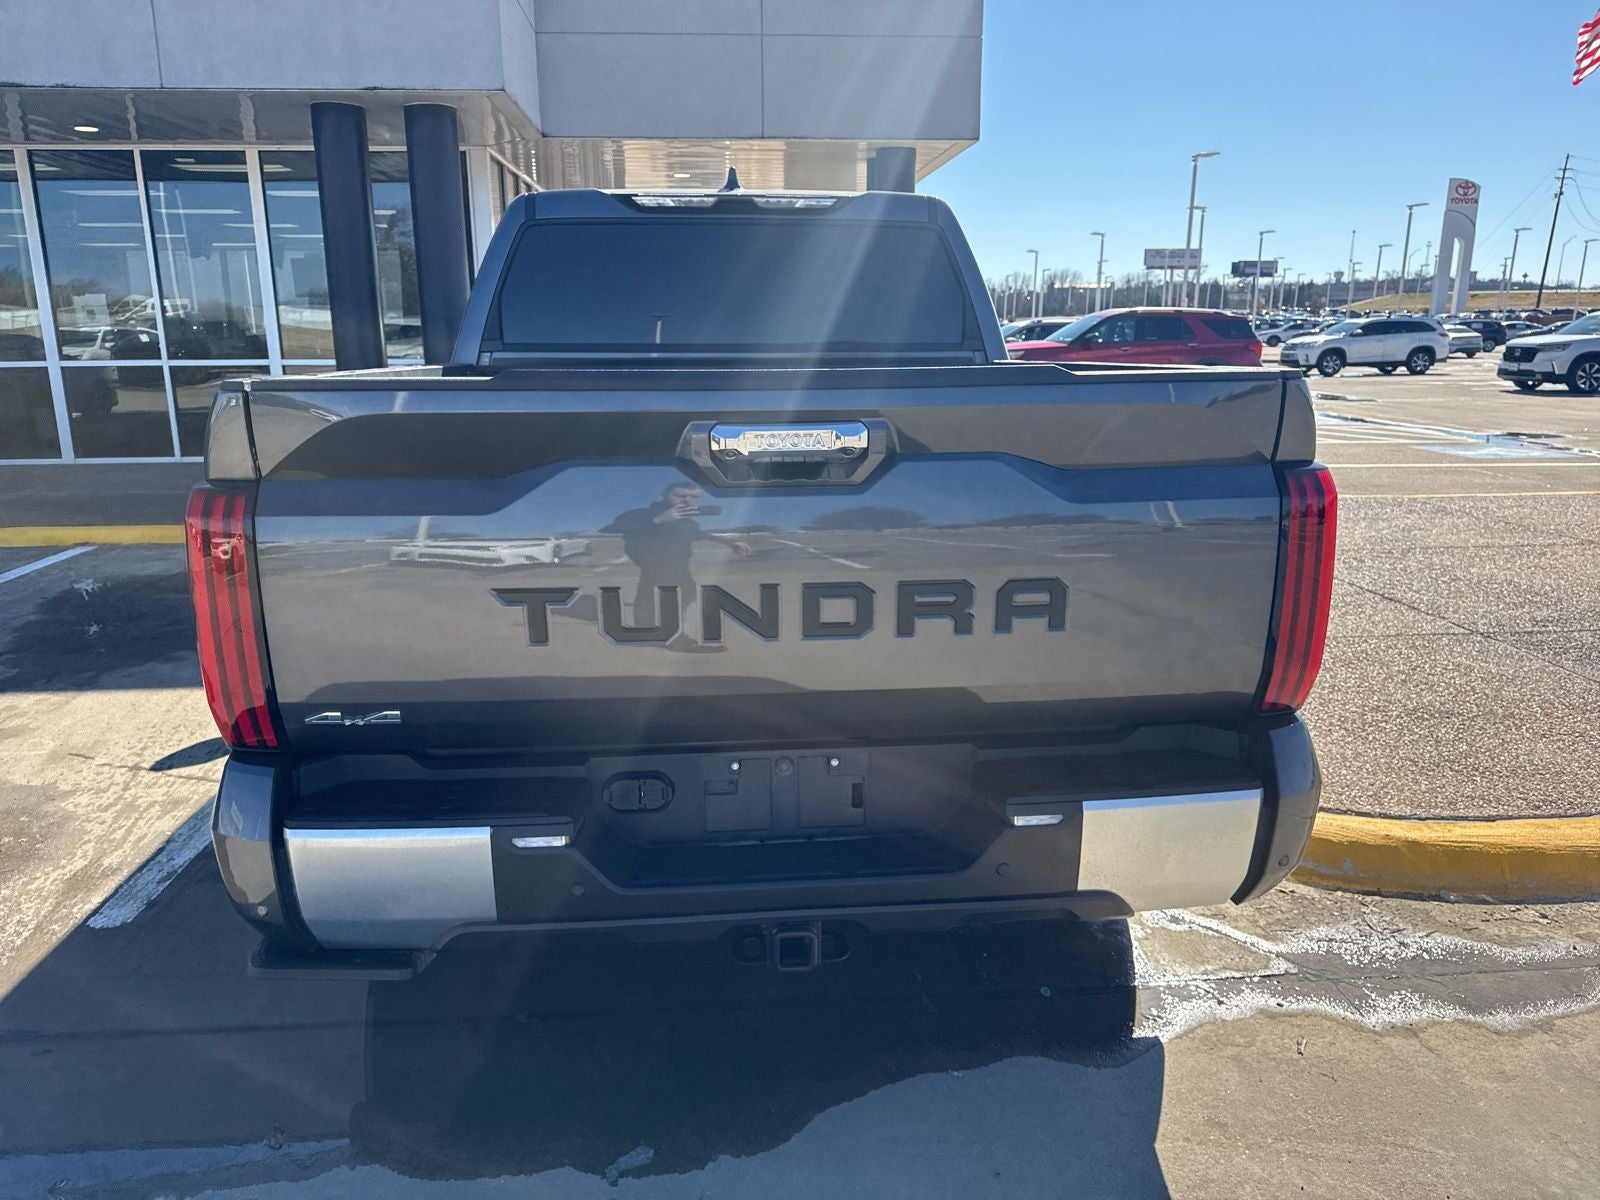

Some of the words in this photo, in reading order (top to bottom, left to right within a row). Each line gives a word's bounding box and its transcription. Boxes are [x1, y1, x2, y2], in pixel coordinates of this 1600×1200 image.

[1450, 197, 1478, 205] TOYOTA
[754, 432, 826, 449] TOYOTA
[490, 576, 1069, 648] TUNDRA
